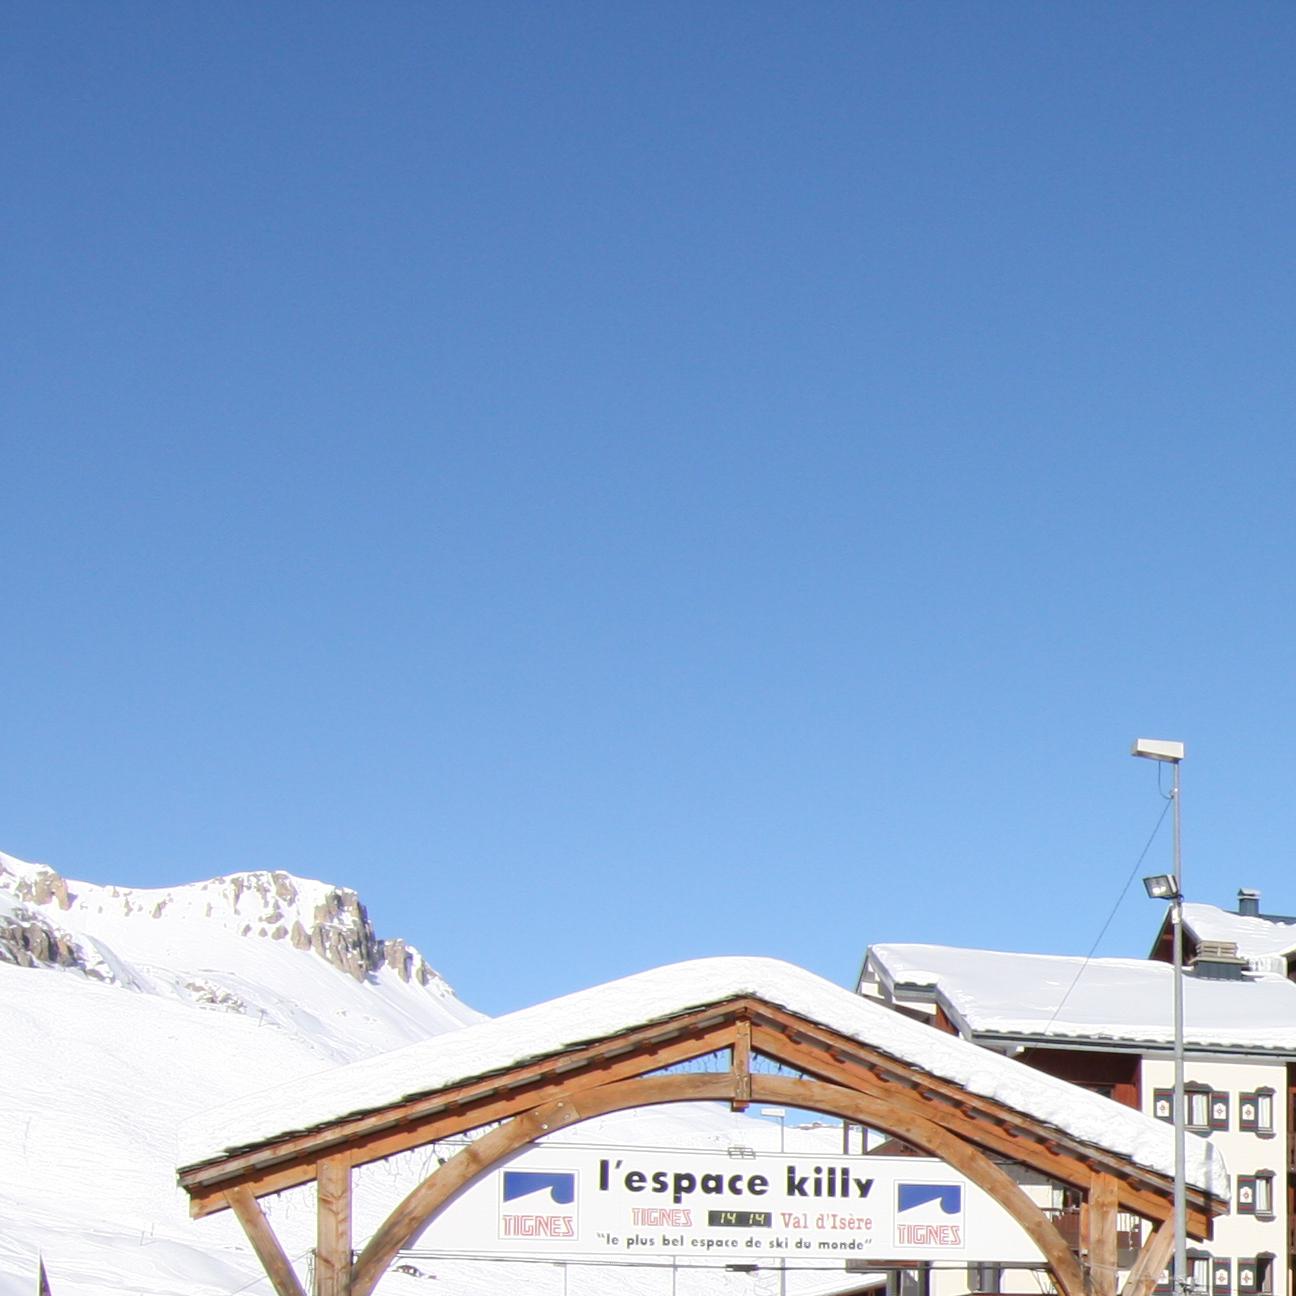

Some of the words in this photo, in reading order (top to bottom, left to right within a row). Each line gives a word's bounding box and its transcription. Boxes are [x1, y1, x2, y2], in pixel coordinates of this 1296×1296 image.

[600, 1159, 769, 1204] l'espace
[786, 1165, 875, 1198] killy
[503, 1215, 575, 1237] TIGNES
[632, 1207, 692, 1227] TIGNES
[780, 1212, 809, 1229] Val
[815, 1212, 873, 1230] d'Isère
[626, 1233, 655, 1249] plus
[661, 1235, 685, 1247] bel
[691, 1236, 739, 1250] espace
[745, 1236, 762, 1249] de
[769, 1237, 789, 1249] ski
[795, 1237, 811, 1249] du
[897, 1224, 961, 1246] TIGNES
